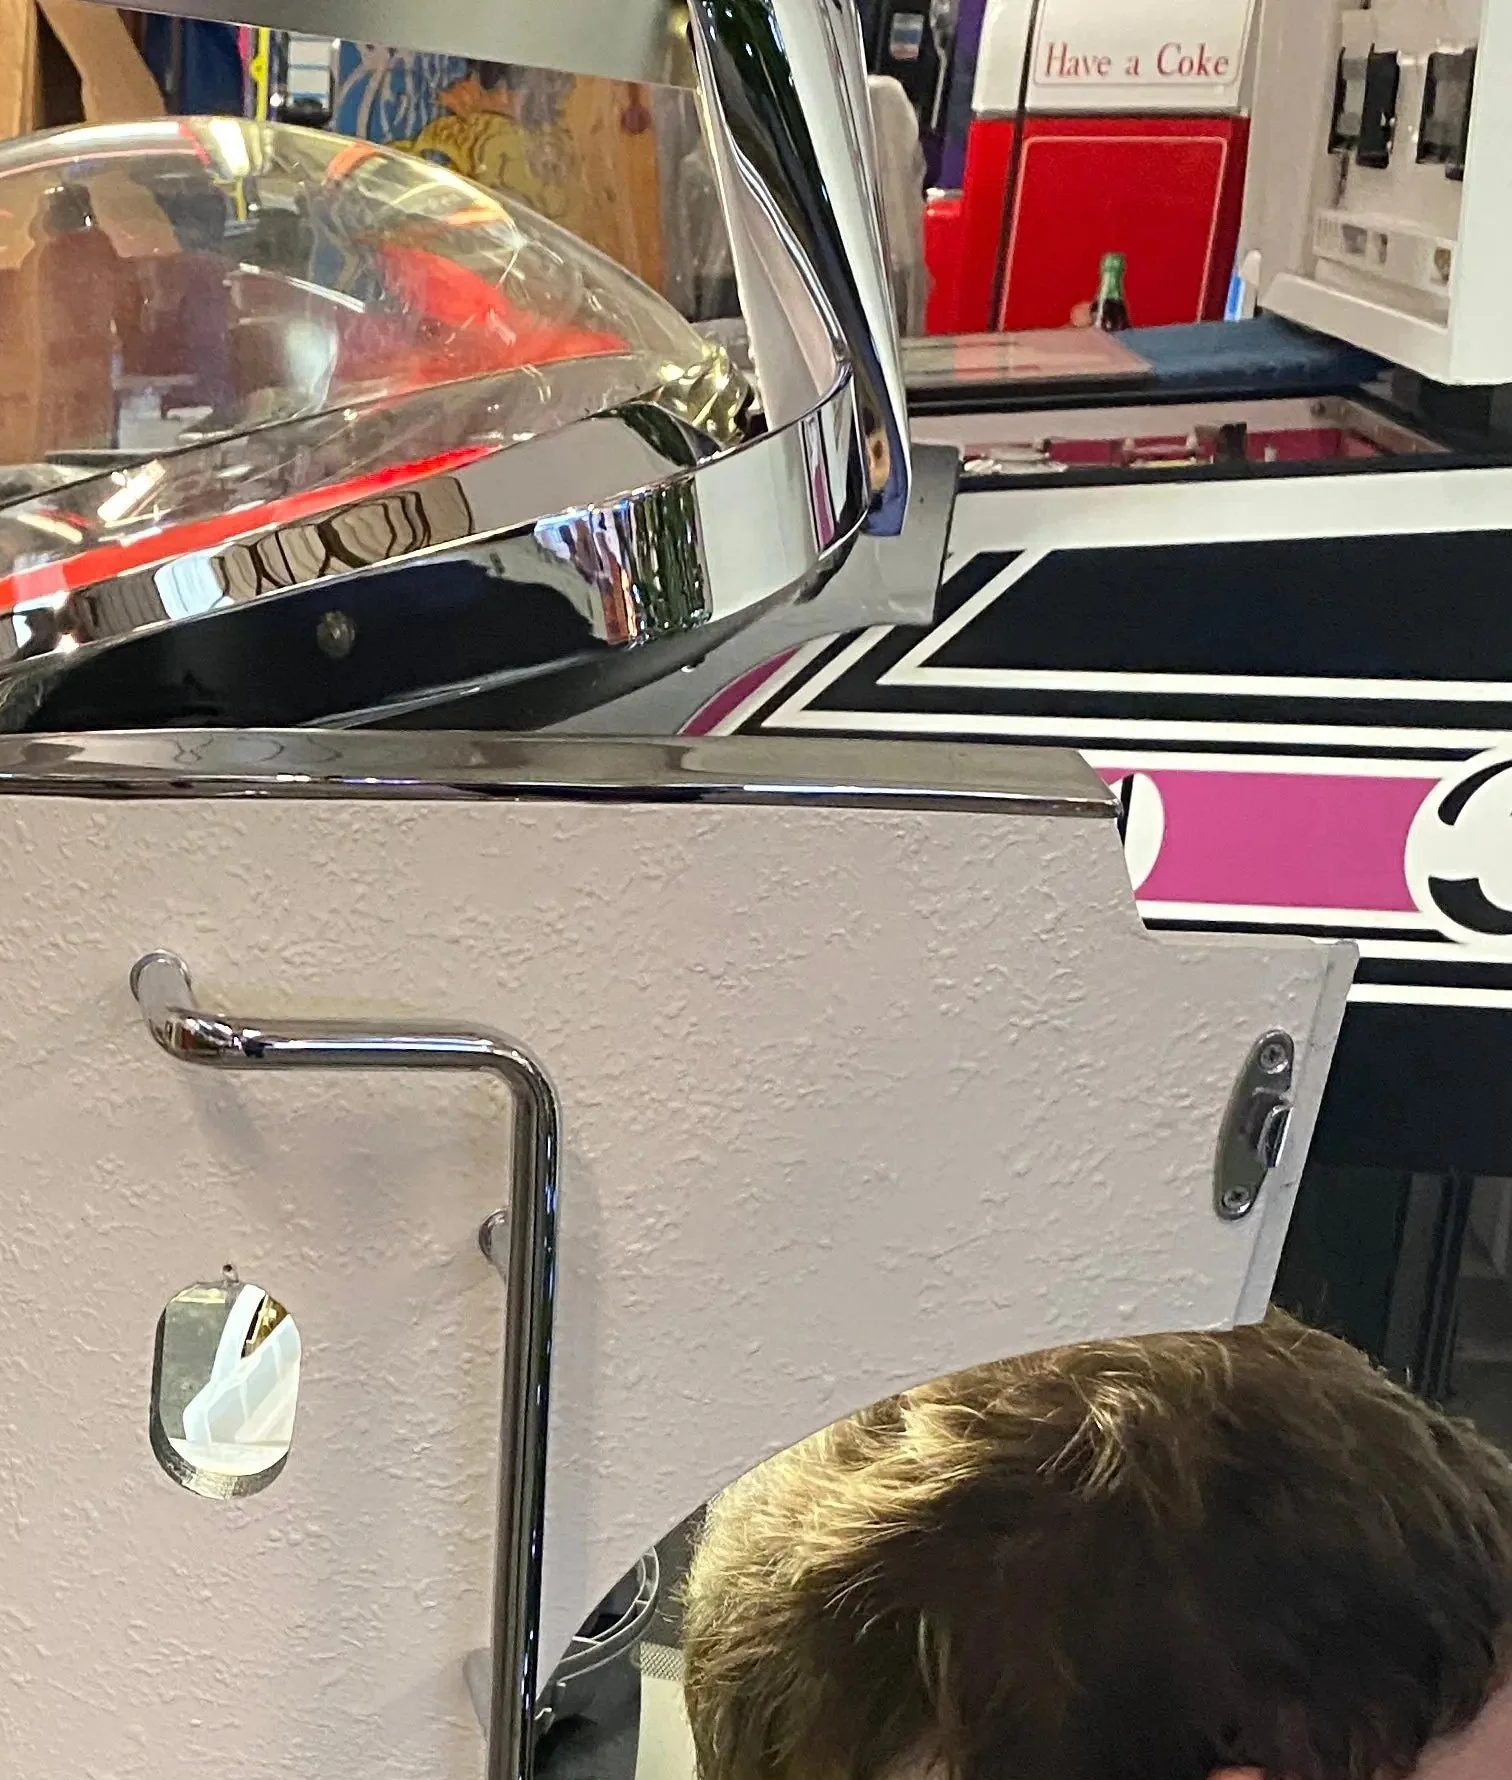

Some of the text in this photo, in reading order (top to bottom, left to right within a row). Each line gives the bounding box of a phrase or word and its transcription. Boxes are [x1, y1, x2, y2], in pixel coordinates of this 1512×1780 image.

[1045, 42, 1229, 78] Have a Coke
